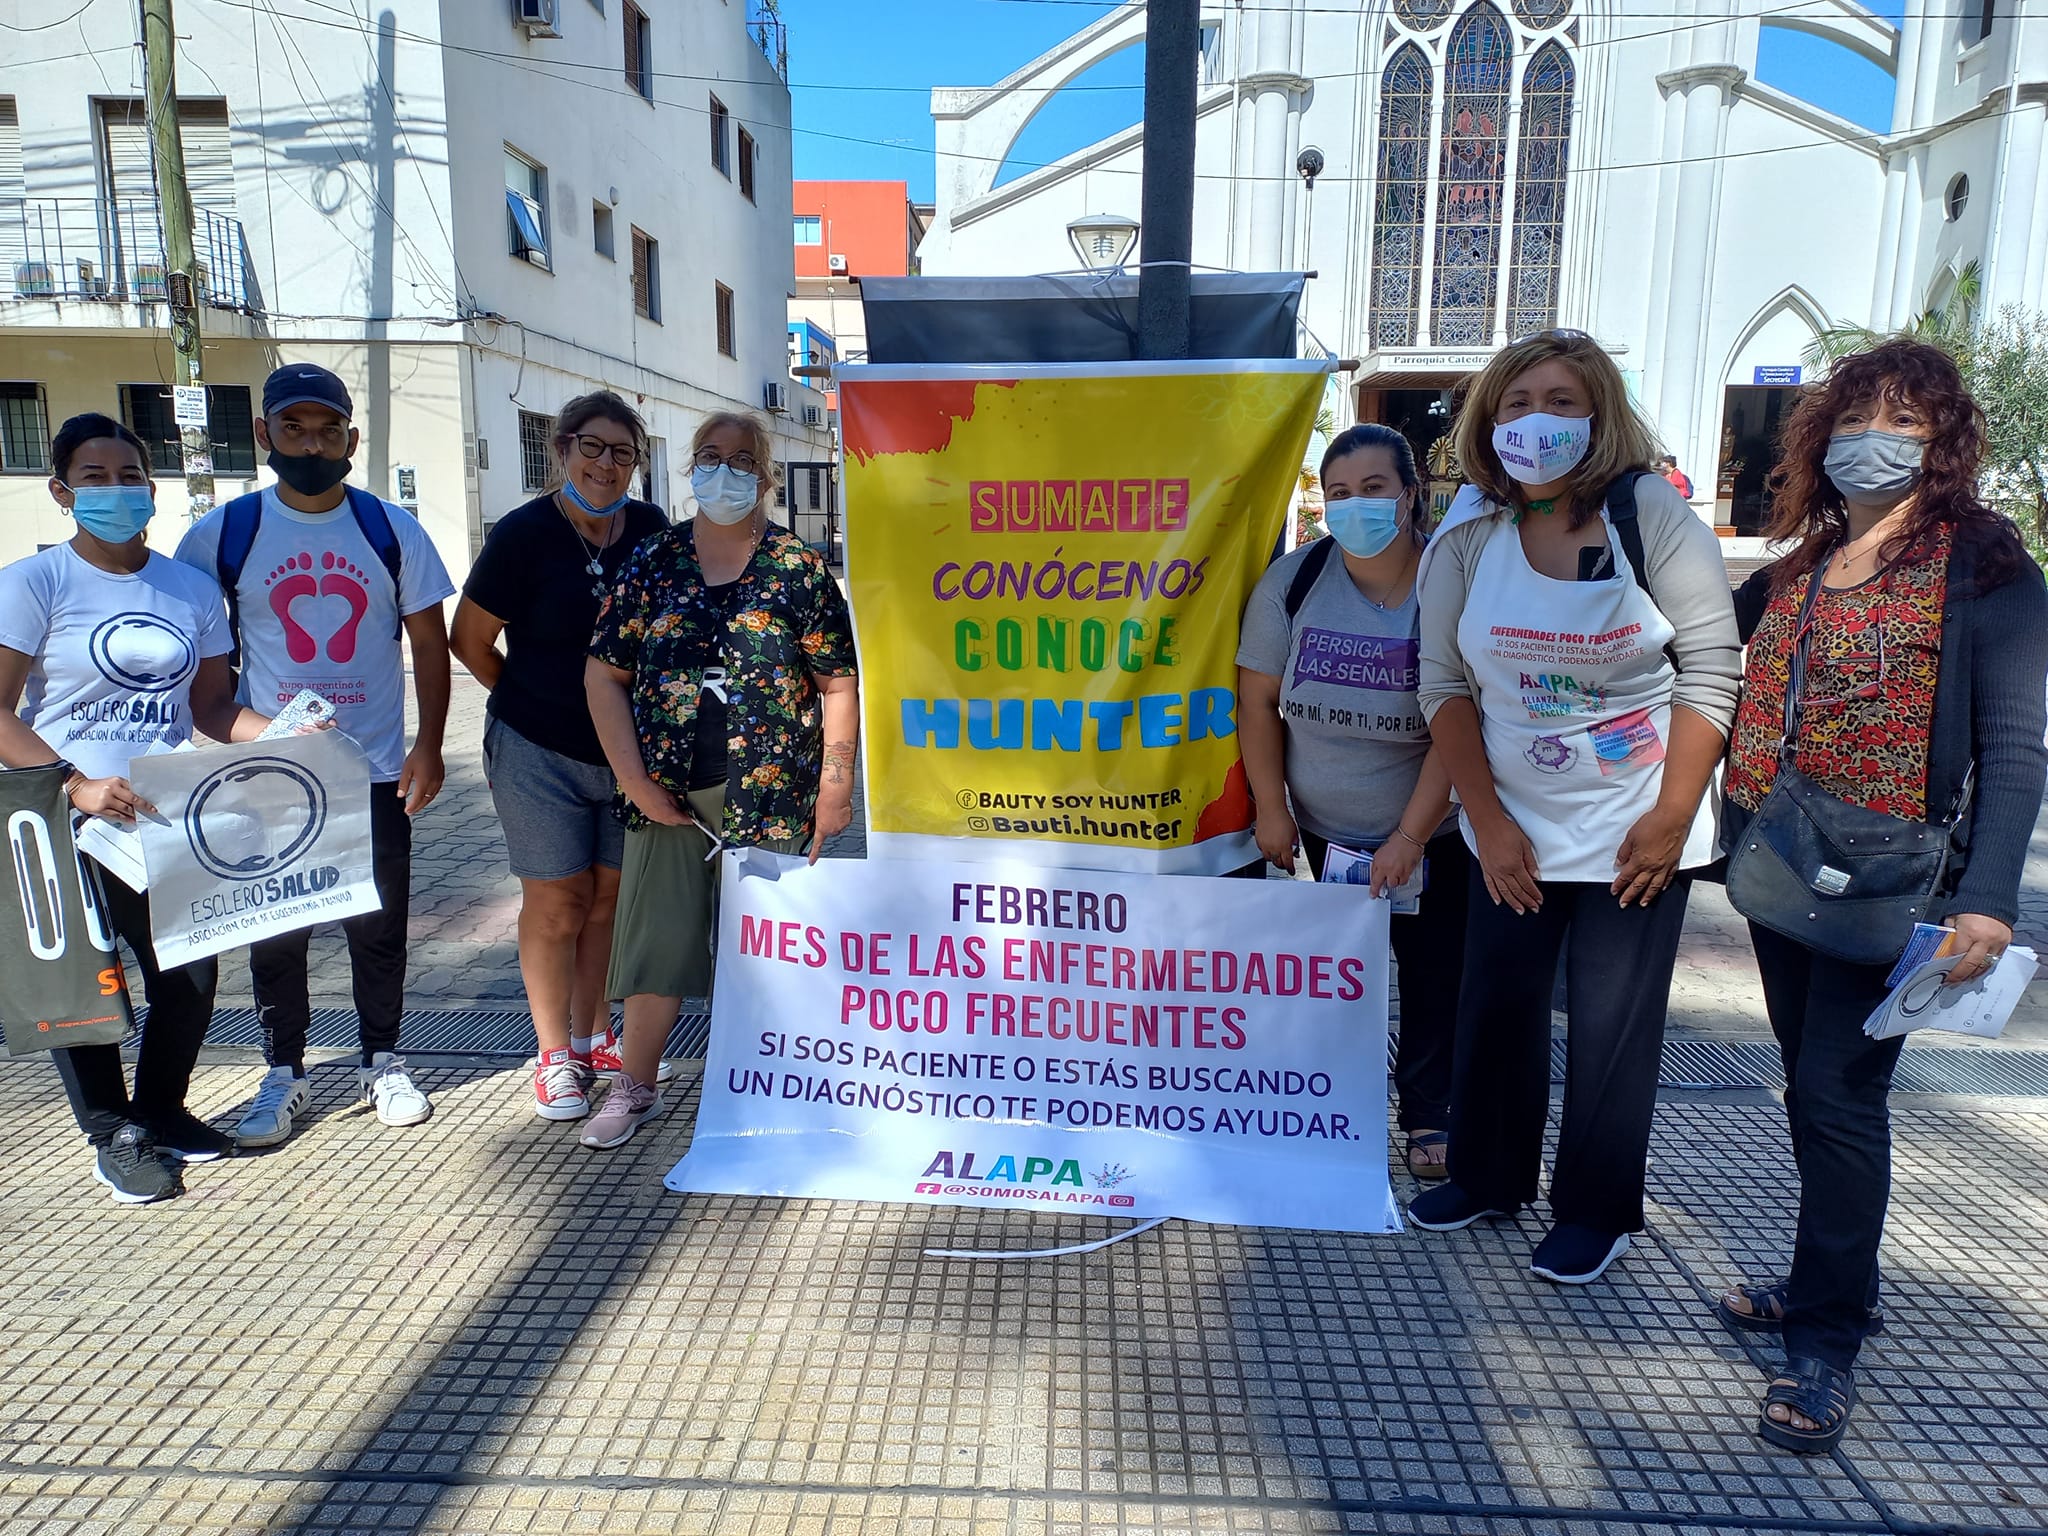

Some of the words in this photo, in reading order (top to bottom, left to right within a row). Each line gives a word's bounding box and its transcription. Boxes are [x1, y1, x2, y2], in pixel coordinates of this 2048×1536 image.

[1393, 356, 1445, 366] Parroquia
[1448, 355, 1492, 364] Catedra
[1506, 430, 1524, 449] P.T.I.
[1539, 431, 1570, 451] ALAPA
[973, 481, 1186, 529] SUMATE
[933, 546, 1210, 601] CONÓCENOS
[954, 613, 1182, 673] CONOCE
[1305, 633, 1385, 660] PERSIGA
[1490, 625, 1557, 643] ENFERMEDADES
[1559, 633, 1585, 644] POCO
[1496, 639, 1503, 647] SI
[1505, 641, 1519, 649] SOS
[1520, 643, 1555, 653] PACIENTE
[1566, 647, 1590, 655] ESTAS
[1592, 638, 1635, 656] BUSCANDO
[1298, 655, 1332, 677] LAS
[1490, 649, 1501, 657] UN
[1503, 650, 1557, 664] DIAGNÓSTICO,
[1558, 657, 1600, 665] PODEMOS
[1602, 647, 1644, 665] AYUDARTE
[306, 680, 353, 691] argentino
[355, 679, 365, 689] de
[1522, 695, 1558, 704] ALIANZA
[901, 687, 1237, 752] HUNTER
[1286, 700, 1304, 718] POR
[1308, 702, 1325, 724] MÍ,
[1329, 709, 1352, 727] POR
[1357, 713, 1372, 731] TI,
[1376, 715, 1401, 732] POR
[979, 792, 1046, 809] BAUTY
[1052, 795, 1094, 810] SOY
[1099, 788, 1182, 810] HUNTER
[993, 814, 1182, 841] Bauti.hunter
[191, 866, 340, 923] ESCLEROSALUD
[952, 883, 1127, 933] FEBRERO
[739, 914, 828, 968] MES
[840, 931, 892, 975] DE
[908, 934, 986, 979] LAS
[1003, 938, 1364, 1001] ENFERMEDADES
[841, 985, 948, 1034] POCO
[966, 992, 1247, 1050] FRECUENTES
[759, 1031, 786, 1058] SI
[793, 1036, 854, 1066] SOS
[863, 1046, 1006, 1081] PACIENTE
[1013, 1056, 1036, 1082] O
[1045, 1057, 1139, 1090] ESTÁS
[1148, 1065, 1332, 1098] BUSCANDO
[728, 1068, 773, 1098] UN
[782, 1074, 996, 1119] DIAGNÓSTICO
[1000, 1096, 1037, 1121] TE
[1047, 1098, 1205, 1133] PODEMOS
[1213, 1107, 1361, 1141] AYUDAR.
[921, 1151, 1084, 1187] ALAPA
[943, 1184, 1105, 1205] @SOMOSALAPA
